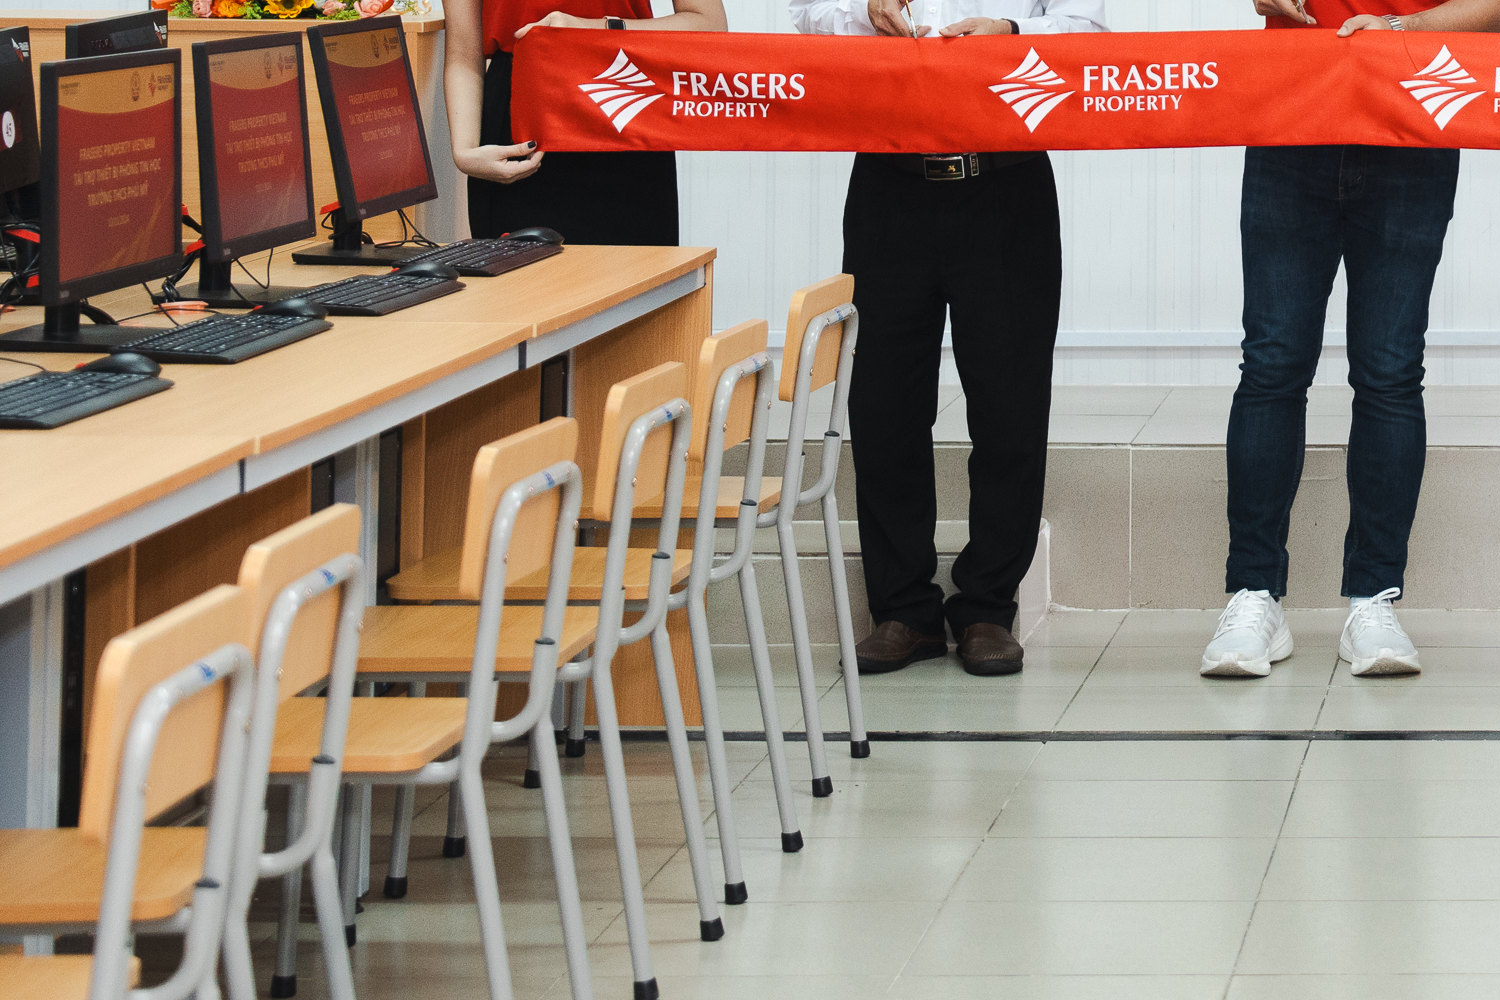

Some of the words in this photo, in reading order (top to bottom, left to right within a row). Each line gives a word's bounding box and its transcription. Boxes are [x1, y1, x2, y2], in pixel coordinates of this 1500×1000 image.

[672, 71, 806, 100] FRASERS
[1083, 61, 1219, 92] FRASERS
[672, 100, 770, 118] PROPERTY
[1083, 94, 1183, 112] PROPERTY
